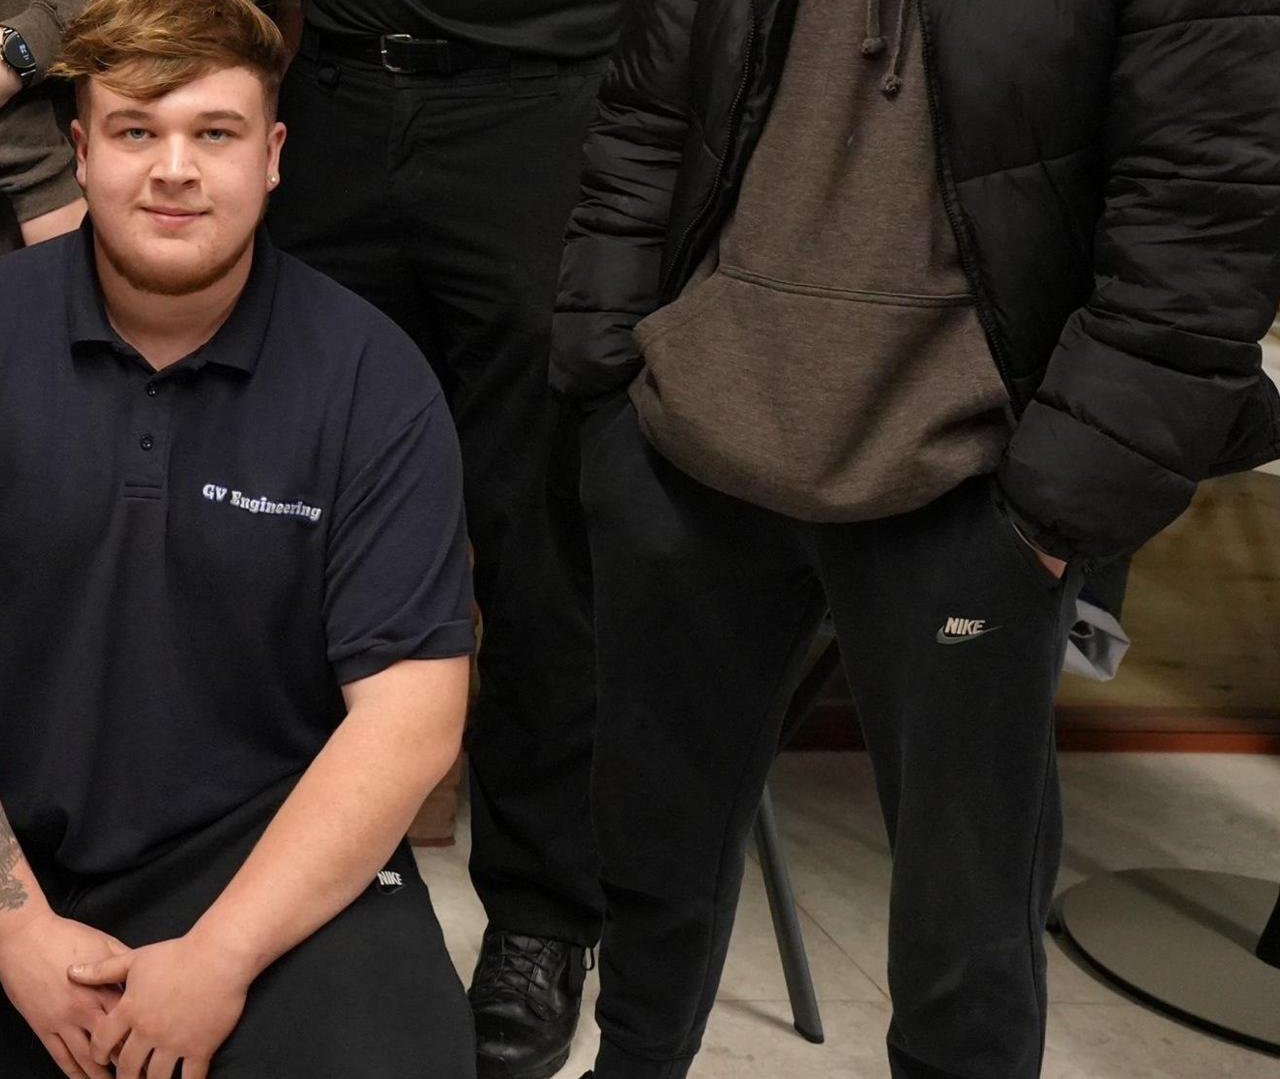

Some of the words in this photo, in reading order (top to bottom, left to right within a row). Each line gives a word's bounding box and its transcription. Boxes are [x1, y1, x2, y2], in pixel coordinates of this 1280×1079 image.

[202, 484, 227, 501] GV
[230, 490, 322, 521] Engineering
[944, 617, 986, 635] NIKE
[377, 870, 403, 886] NIKE
